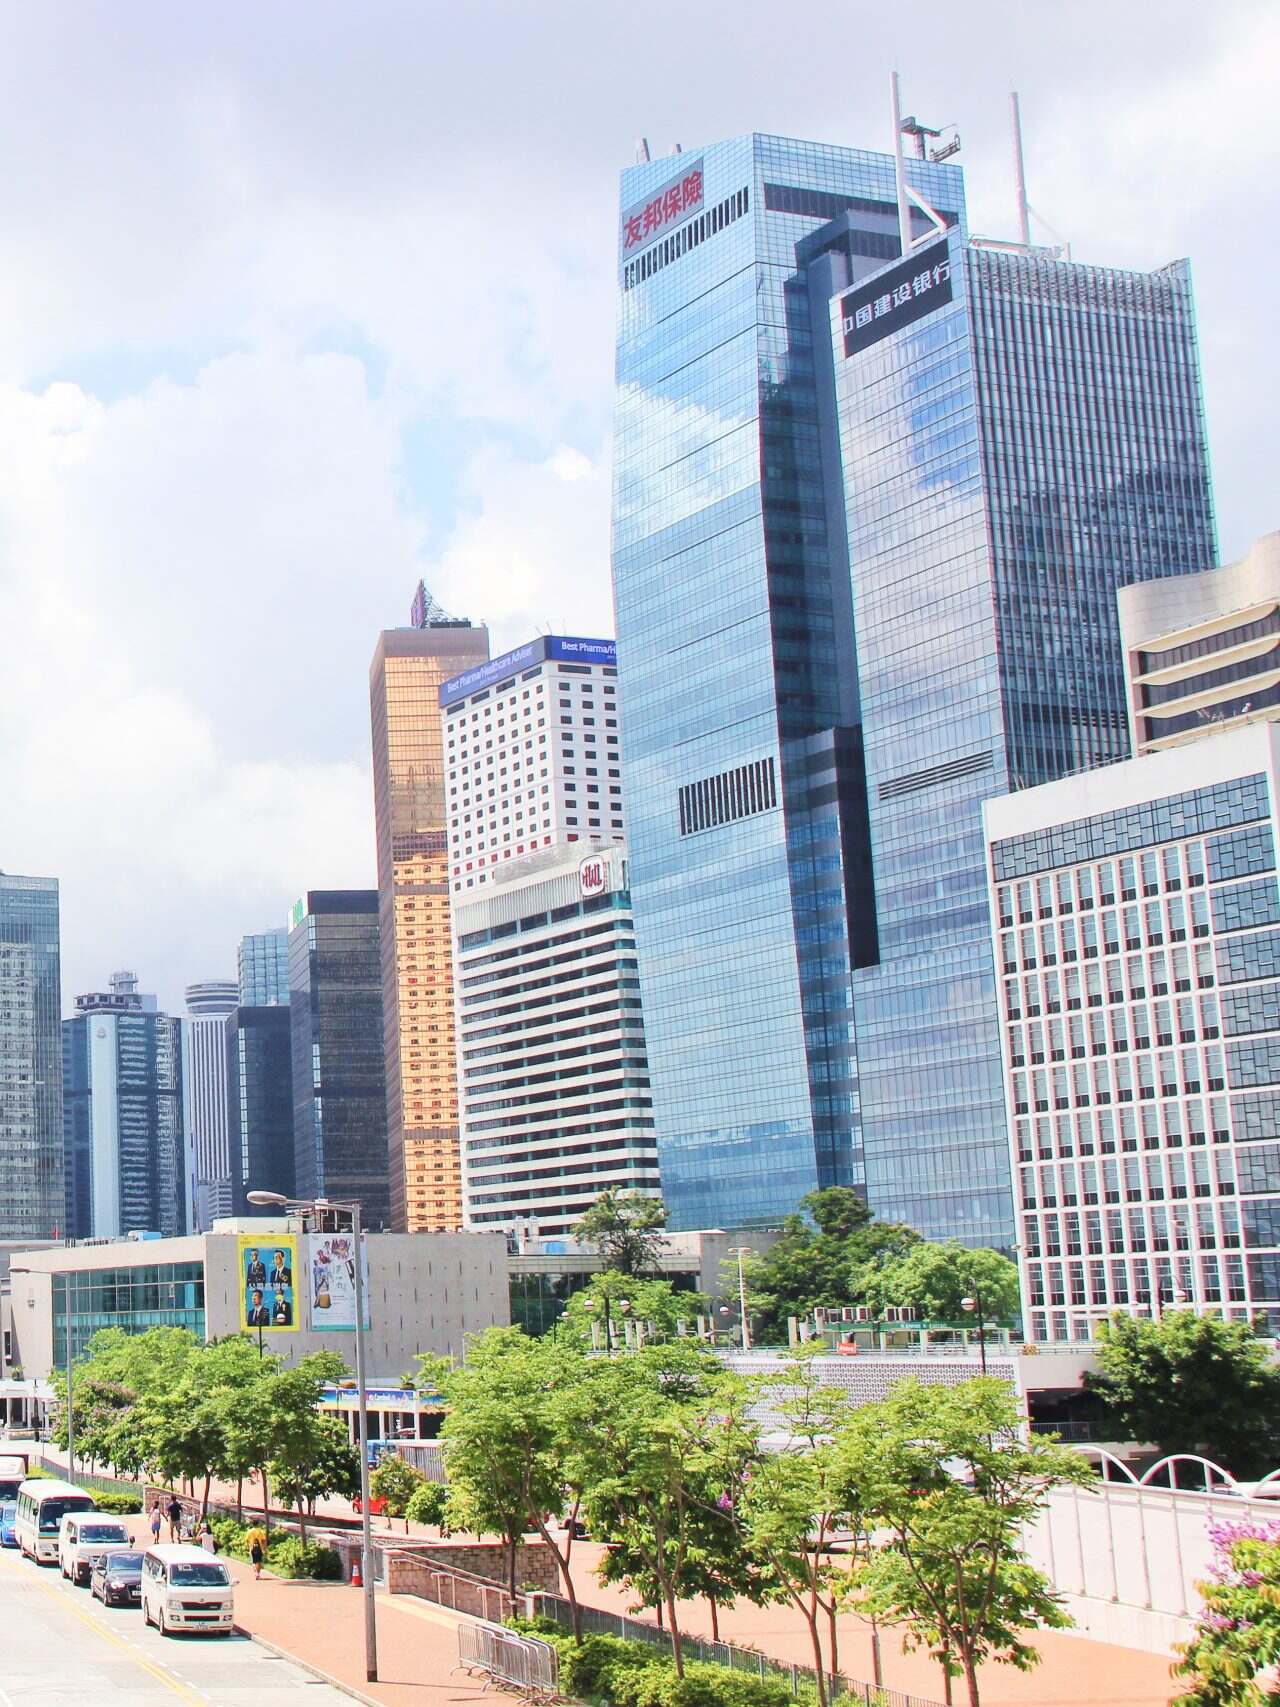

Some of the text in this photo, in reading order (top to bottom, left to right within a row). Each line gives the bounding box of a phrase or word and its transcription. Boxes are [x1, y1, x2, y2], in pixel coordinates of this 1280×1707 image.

[624, 170, 703, 248] 友邦保險
[842, 260, 951, 336] 中国建设银行
[561, 641, 578, 652] Best
[447, 681, 459, 694] Best
